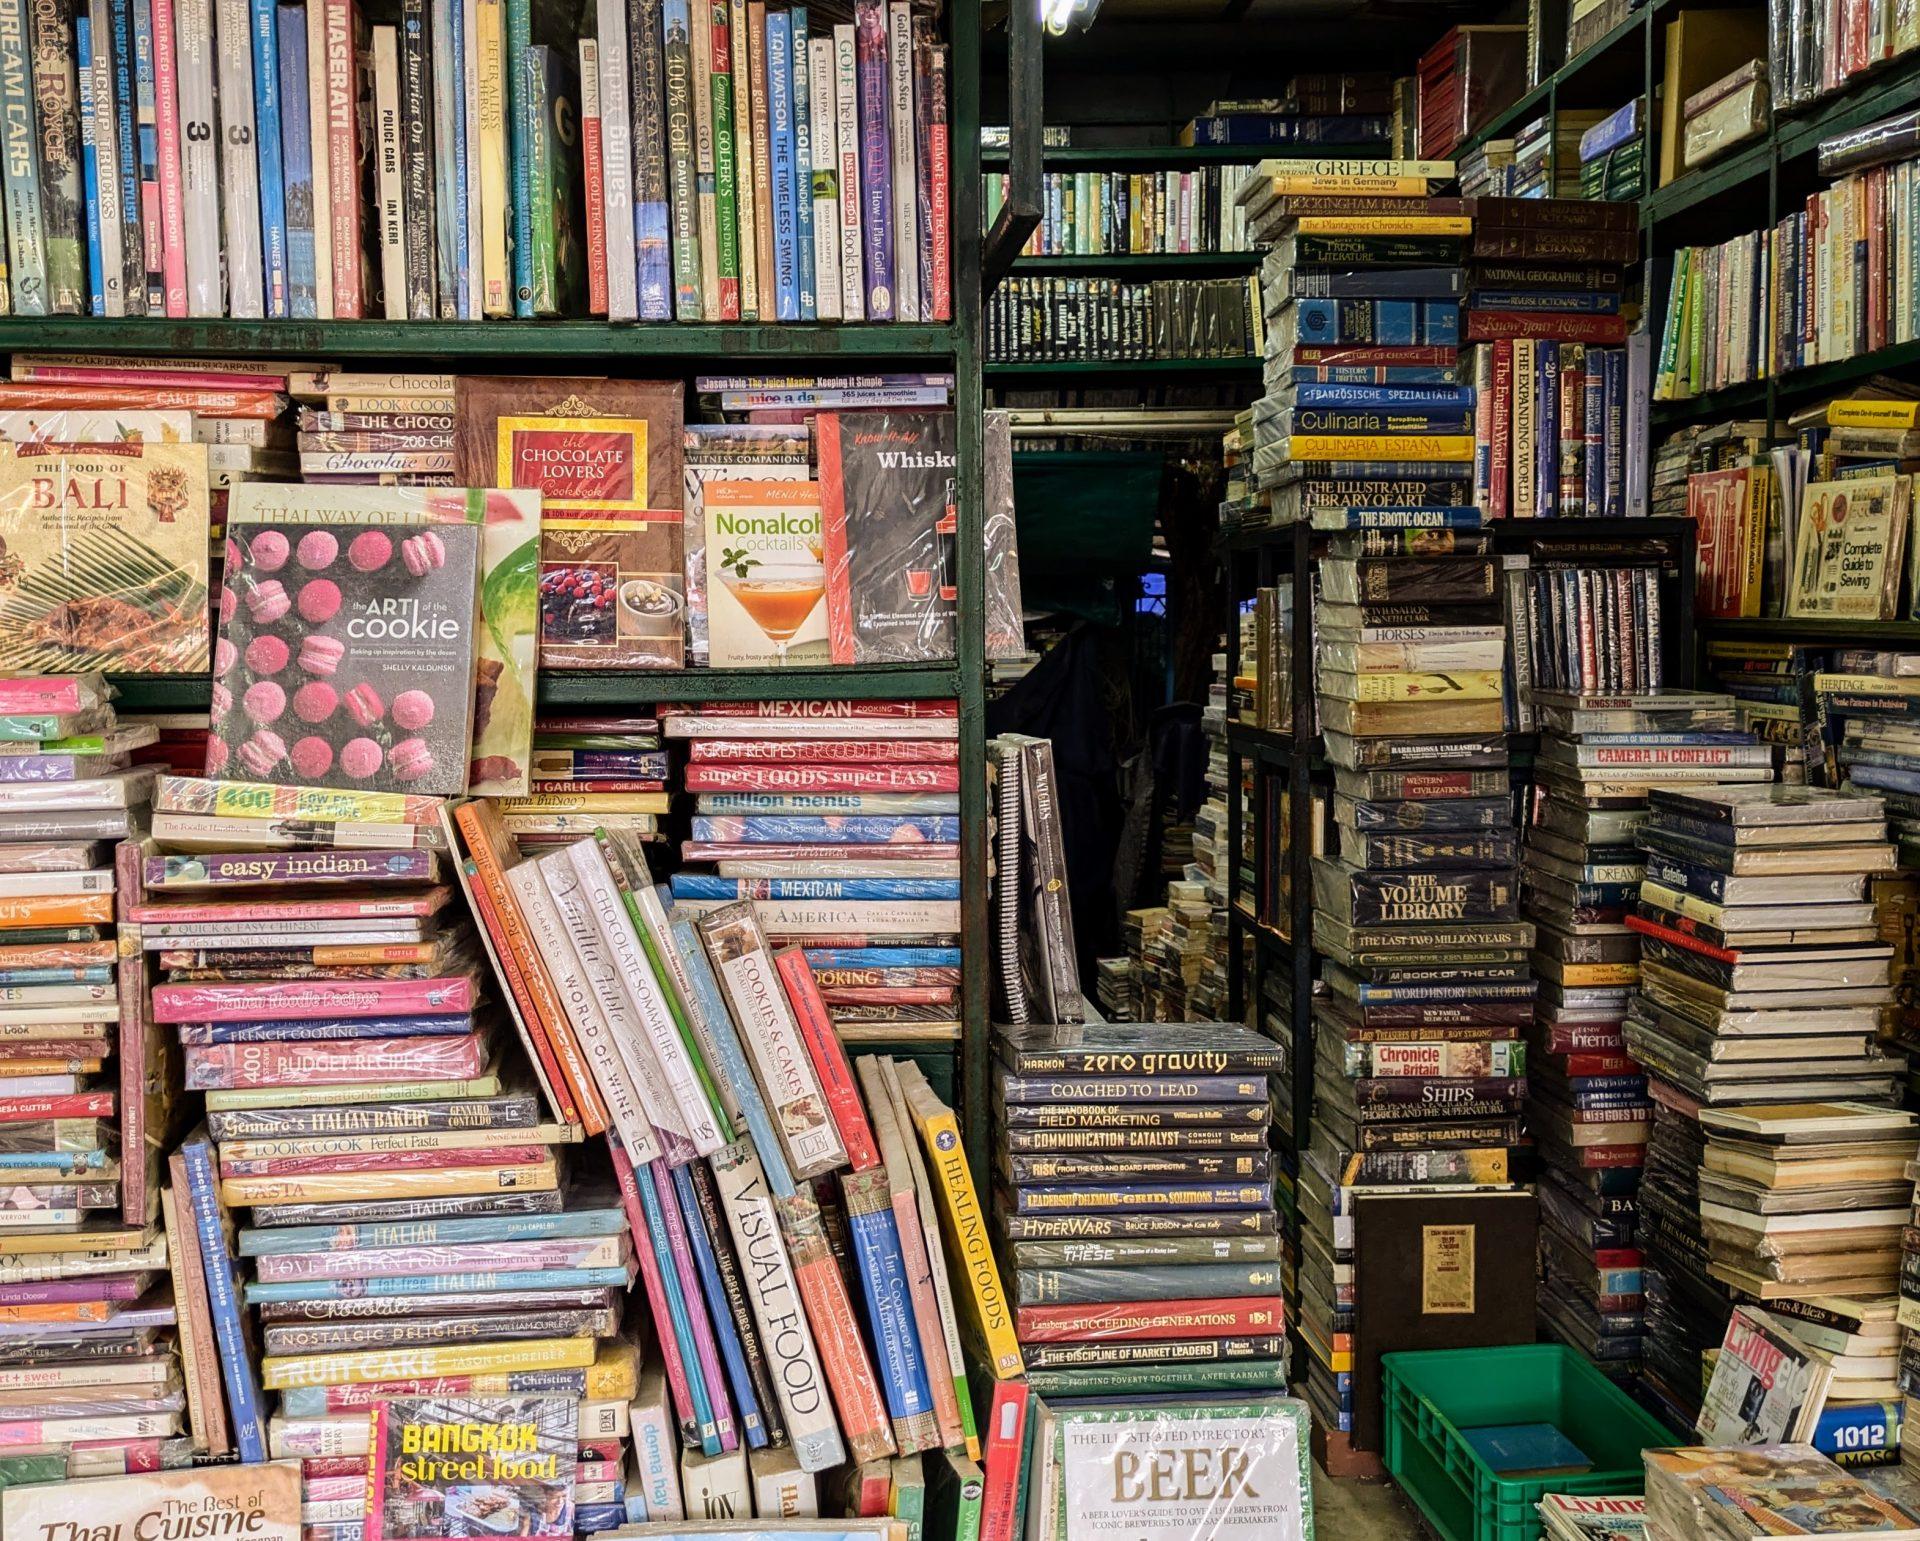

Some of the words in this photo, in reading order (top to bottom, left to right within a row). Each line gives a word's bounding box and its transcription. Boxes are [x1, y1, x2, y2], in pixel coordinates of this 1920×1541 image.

[896, 14, 908, 39] Golf
[716, 47, 726, 67] The
[751, 24, 764, 84] step-by-step
[772, 31, 785, 64] TOM
[794, 30, 807, 86] LOWER
[328, 5, 348, 128] MASERATI
[819, 58, 828, 82] THE
[896, 41, 910, 110] Step-by-Step
[409, 50, 422, 115] America
[603, 46, 620, 119] Yachts
[669, 54, 685, 106] 100%
[94, 56, 110, 130] PICKUP
[160, 76, 172, 122] HISTORY
[715, 76, 729, 122] Complete
[752, 90, 767, 116] golf
[774, 68, 787, 131] WATSON
[796, 91, 806, 120] YOUR
[820, 86, 829, 127] IMPACT
[164, 128, 173, 142] OF
[383, 110, 394, 143] POLICE
[412, 121, 423, 143] On
[671, 112, 689, 151] Golf
[756, 119, 769, 188] techniques
[777, 136, 788, 164] THE
[797, 124, 810, 166] GOLF
[822, 132, 830, 163] ZONE
[165, 146, 174, 176] ROAD
[385, 148, 396, 173] CARS
[607, 126, 626, 208] Sailing
[718, 130, 733, 196] GOLFER'S
[1316, 161, 1400, 176] GREECE
[100, 138, 114, 220] TRUCKS
[412, 151, 424, 199] Wheels
[677, 160, 687, 196] DAVID
[1353, 178, 1397, 186] Germany
[387, 200, 398, 216] IAN
[778, 168, 790, 234] TIMELESS
[799, 170, 810, 223] HANDICAP
[167, 184, 178, 248] TRANSPORT
[388, 220, 399, 244] KERR
[679, 200, 691, 274] LEADBETTER
[722, 206, 733, 274] HANDBOOK
[272, 227, 280, 267] HAYNES
[780, 238, 792, 286] SWING
[1485, 269, 1524, 281] NATIONAL
[1527, 269, 1584, 282] GEOGRAPHIC
[1485, 318, 1519, 331] Know
[1523, 320, 1552, 335] your
[1556, 316, 1595, 333] Rights
[1519, 344, 1529, 368] THE
[1519, 373, 1528, 443] EXPANDING
[1301, 412, 1380, 430] Culinaria
[522, 449, 622, 462] CHOCOLATE
[1305, 439, 1378, 451] CULINARIA
[1385, 436, 1441, 451] ESPAÑA
[327, 452, 417, 470] Chocolate
[544, 463, 604, 478] LOVER'S
[737, 455, 807, 464] COMPANIONS
[1519, 447, 1528, 503] WORLD
[32, 478, 128, 509] BALI
[540, 480, 603, 496] Cookbook
[1359, 513, 1378, 526] THE
[1380, 512, 1412, 526] EROTIC
[1413, 513, 1444, 526] OCEAN
[1844, 543, 1882, 557] Complete
[1842, 558, 1863, 571] Guide
[1865, 558, 1873, 569] to
[1840, 573, 1870, 588] Sewing
[347, 599, 459, 639] cookie
[353, 602, 367, 610] the
[366, 598, 412, 615] ART
[423, 602, 431, 611] of
[434, 602, 447, 611] the
[1376, 629, 1425, 641] HORSES
[758, 701, 851, 718] MEXICAN
[857, 705, 893, 713] COOKING
[1598, 750, 1650, 762] CAMERA
[1656, 751, 1668, 762] IN
[1672, 750, 1731, 762] CONFLICT
[700, 771, 750, 787] super
[757, 770, 828, 784] FOODS
[833, 771, 884, 785] super
[890, 771, 941, 785] EASY
[713, 793, 784, 807] million
[792, 794, 861, 807] menus
[220, 860, 277, 880] easy
[287, 856, 369, 873] indian
[1662, 866, 1687, 887] dateline
[781, 882, 842, 897] MEXICAN
[1380, 886, 1467, 902] VOLUME
[1380, 903, 1466, 920] LIBRARY
[1403, 971, 1440, 979] BOOK
[742, 957, 780, 1028] COOKIES
[566, 975, 598, 1038] WORLD
[594, 1044, 610, 1068] OF
[607, 1071, 635, 1120] WINE
[770, 1029, 783, 1043] &
[1024, 1060, 1064, 1069] HARMON
[1084, 1055, 1136, 1072] zero
[1142, 1053, 1227, 1074] gravity
[1380, 1048, 1440, 1062] Chronicle
[774, 1040, 804, 1098] CAKES
[1403, 1064, 1440, 1076] Britain
[1051, 1085, 1123, 1097] COACHED
[1126, 1085, 1151, 1096] TO
[1160, 1085, 1198, 1096] LEAD
[1422, 1086, 1475, 1102] SHIPS
[312, 1111, 369, 1131] ITALIAN
[374, 1109, 430, 1129] BAKERY
[1039, 1115, 1077, 1126] FIELD
[1080, 1115, 1161, 1126] MARKETING
[1035, 1133, 1124, 1147] COMMUNICATION
[1130, 1132, 1179, 1145] CATALYST
[944, 1157, 985, 1259] HEALING
[973, 1258, 1006, 1330] FOODS
[734, 1177, 789, 1306] VISUAL
[768, 1313, 820, 1415] FOOD
[282, 1329, 384, 1345] NOSTALGIC
[393, 1324, 480, 1339] DELIGHTS
[1073, 1317, 1150, 1330] SUCCEEDING
[1152, 1314, 1236, 1326] GENERATIONS
[1048, 1352, 1065, 1362] THE
[1067, 1350, 1117, 1361] DISCIPLINE
[1120, 1349, 1130, 1359] OF
[1132, 1348, 1171, 1358] MARKET
[1172, 1345, 1212, 1356] LEADERS
[271, 1360, 354, 1385] FRUIT
[361, 1355, 437, 1377] CAKE
[453, 1358, 491, 1368] JASON
[496, 1349, 566, 1363] SCHREIBER
[1069, 1378, 1108, 1386] FIGHTING
[1111, 1376, 1148, 1384] POVERTY
[403, 1424, 537, 1453] BANGKOK
[1833, 1426, 1884, 1447] 1012
[646, 1424, 663, 1475] donna
[401, 1458, 490, 1482] street
[493, 1454, 558, 1479] food
[1111, 1449, 1260, 1502] BEER
[163, 1499, 197, 1515] The
[203, 1495, 240, 1511] Best
[248, 1490, 264, 1507] of
[652, 1480, 668, 1507] hay
